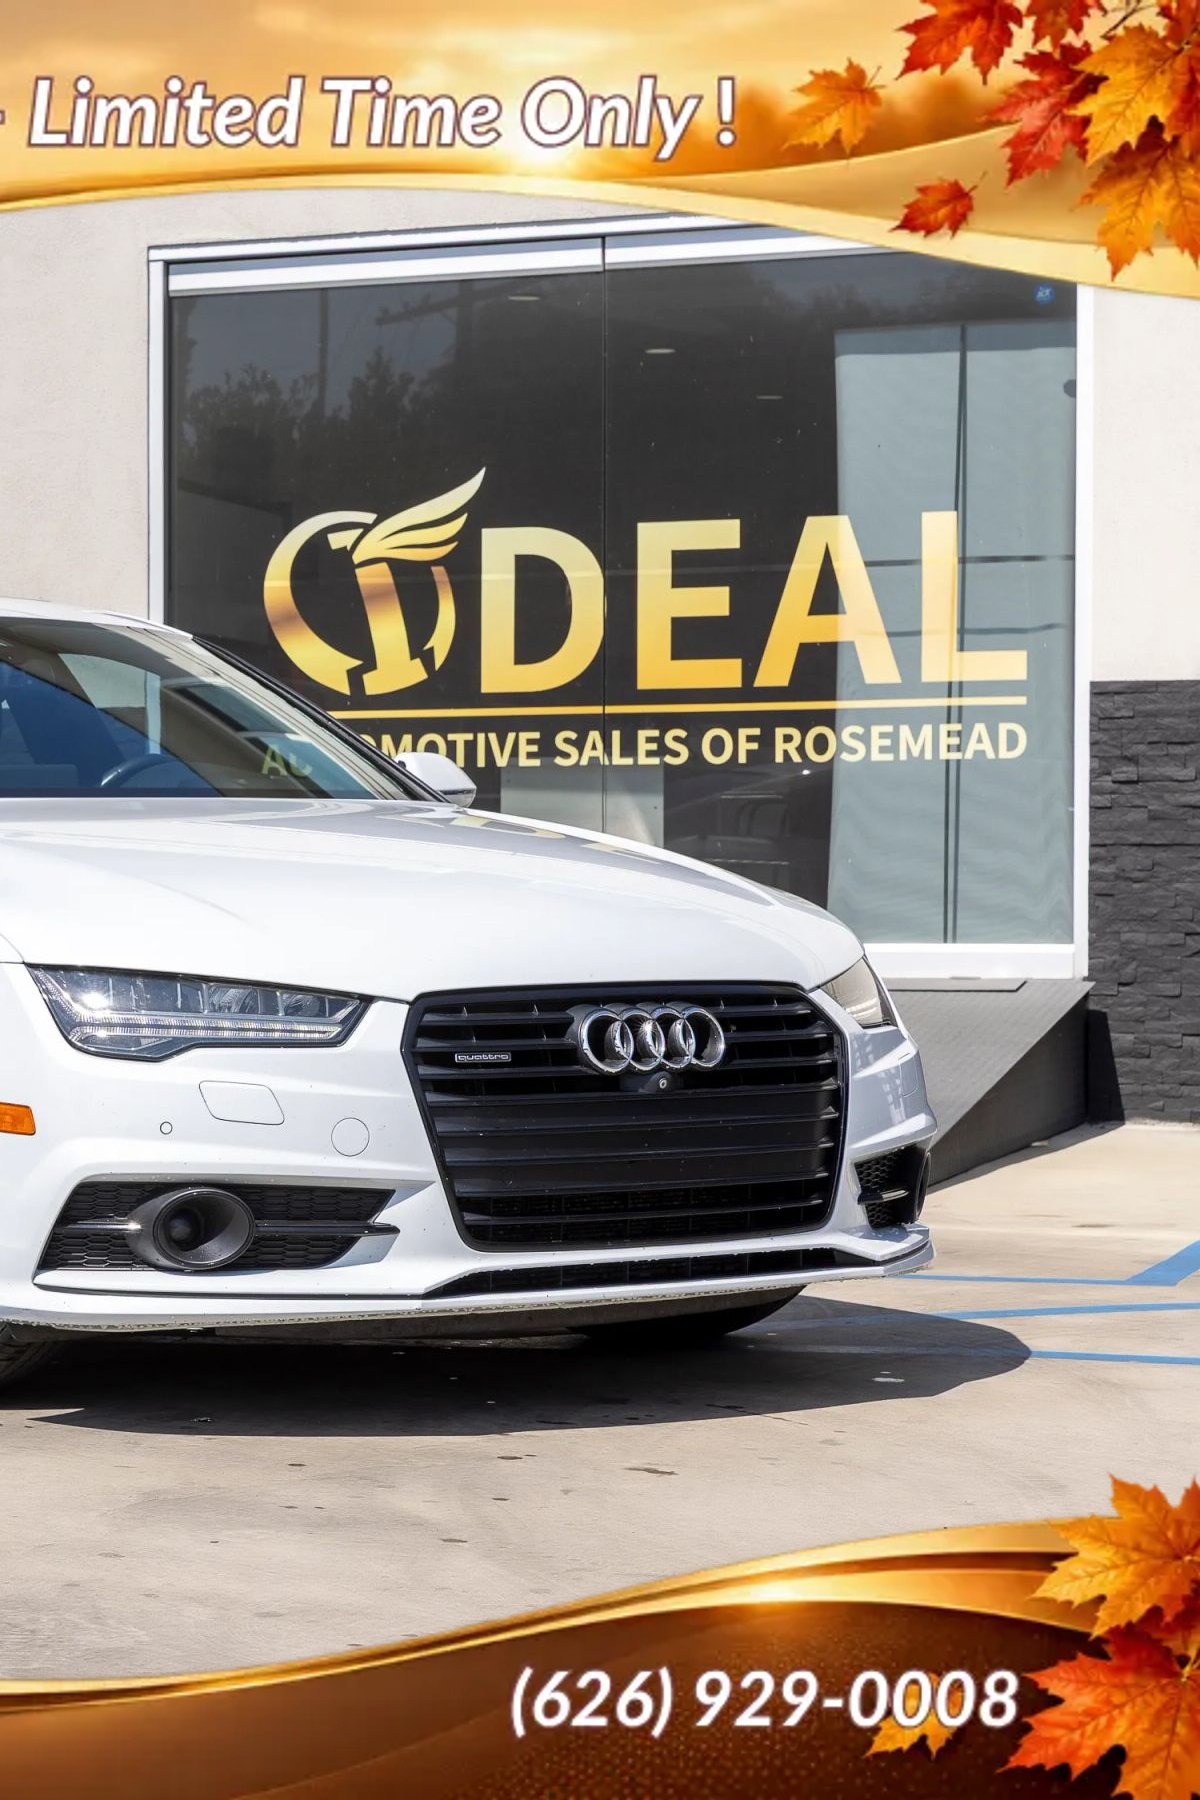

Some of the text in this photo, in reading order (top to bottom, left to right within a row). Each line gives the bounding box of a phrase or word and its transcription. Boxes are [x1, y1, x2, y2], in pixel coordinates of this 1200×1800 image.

[554, 724, 689, 767] SALES
[701, 727, 761, 764] OF
[775, 722, 1028, 763] ROSEMEAD
[457, 1054, 509, 1062] quattro
